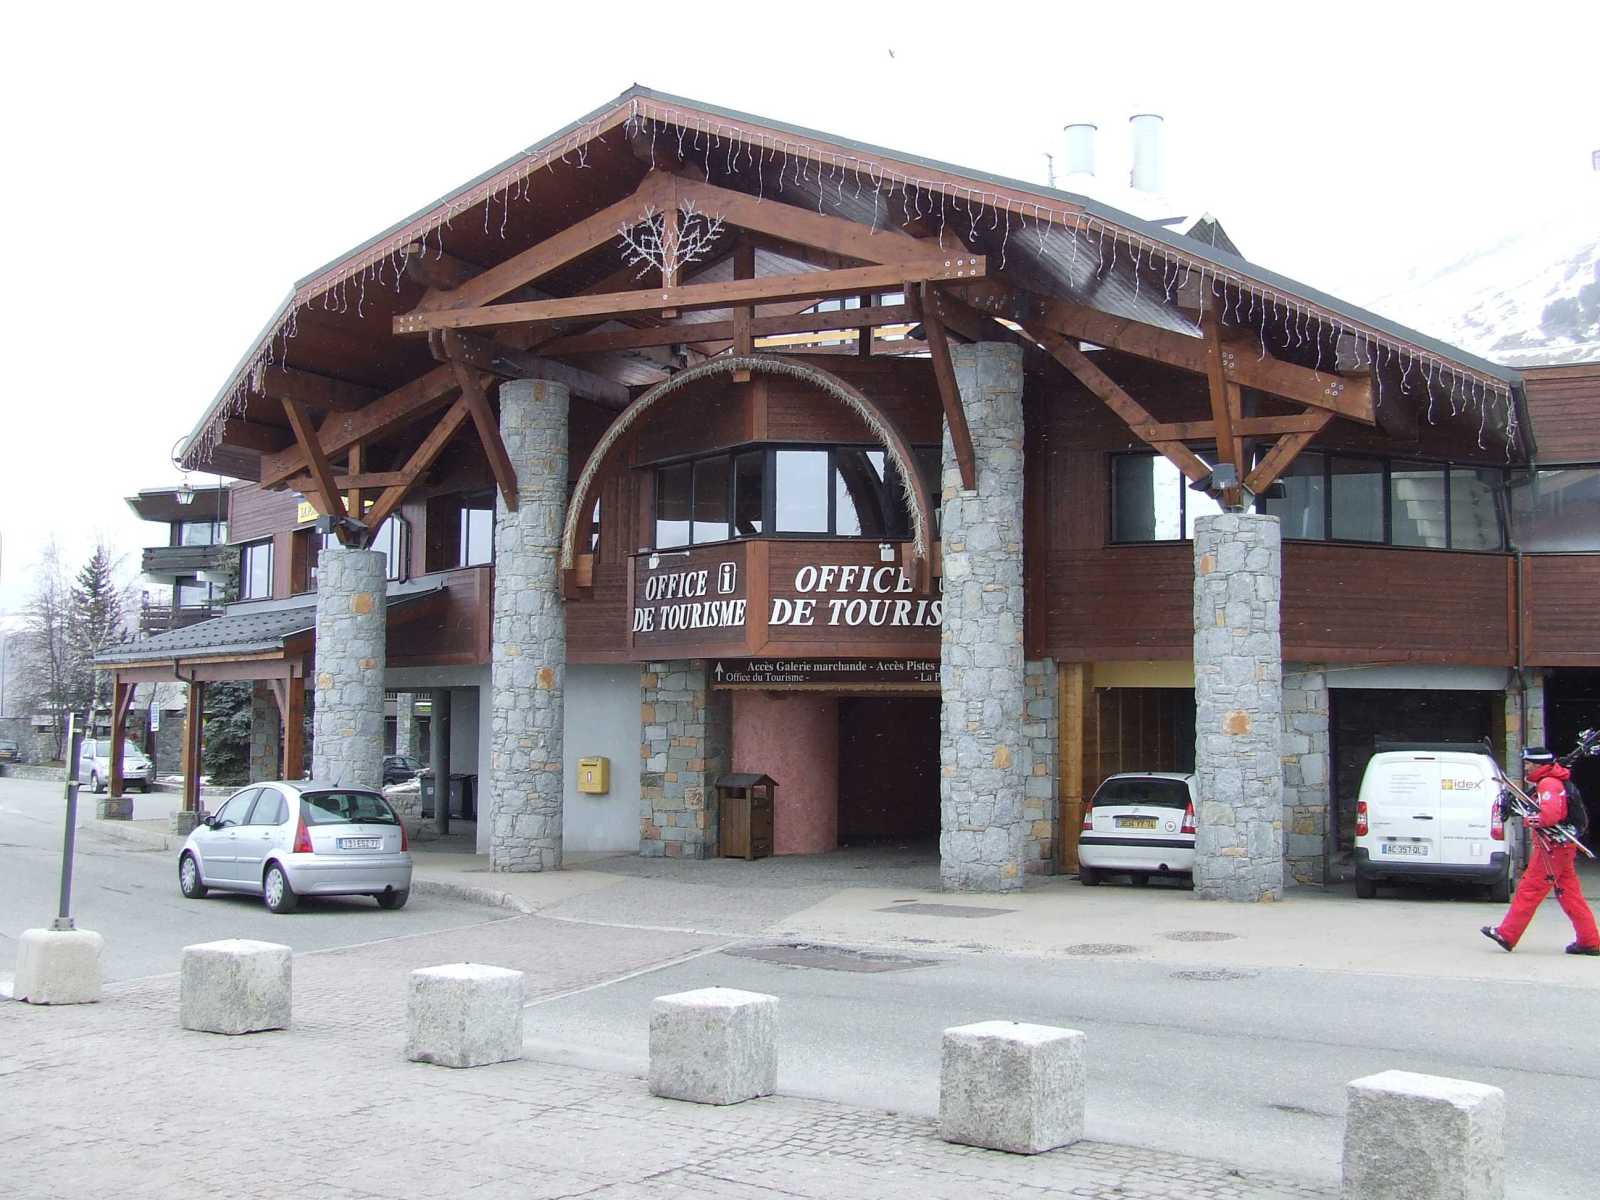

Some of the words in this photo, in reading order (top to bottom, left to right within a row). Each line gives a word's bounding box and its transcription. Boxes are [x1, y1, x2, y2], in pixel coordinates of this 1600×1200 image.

[645, 570, 708, 601] OFFICE
[632, 607, 655, 632] DE
[660, 599, 747, 630] TOURISME
[768, 598, 817, 626] DE
[828, 598, 943, 626] TOURIS
[747, 660, 774, 672] Accès
[776, 660, 812, 672] Galerie
[813, 660, 867, 672] marchande
[876, 660, 904, 671] Accès
[906, 660, 936, 671] Pistes
[726, 672, 751, 682] Office
[752, 672, 763, 682] du
[765, 672, 804, 682] Tourisme
[920, 671, 932, 682] La
[1454, 778, 1485, 790] idex
